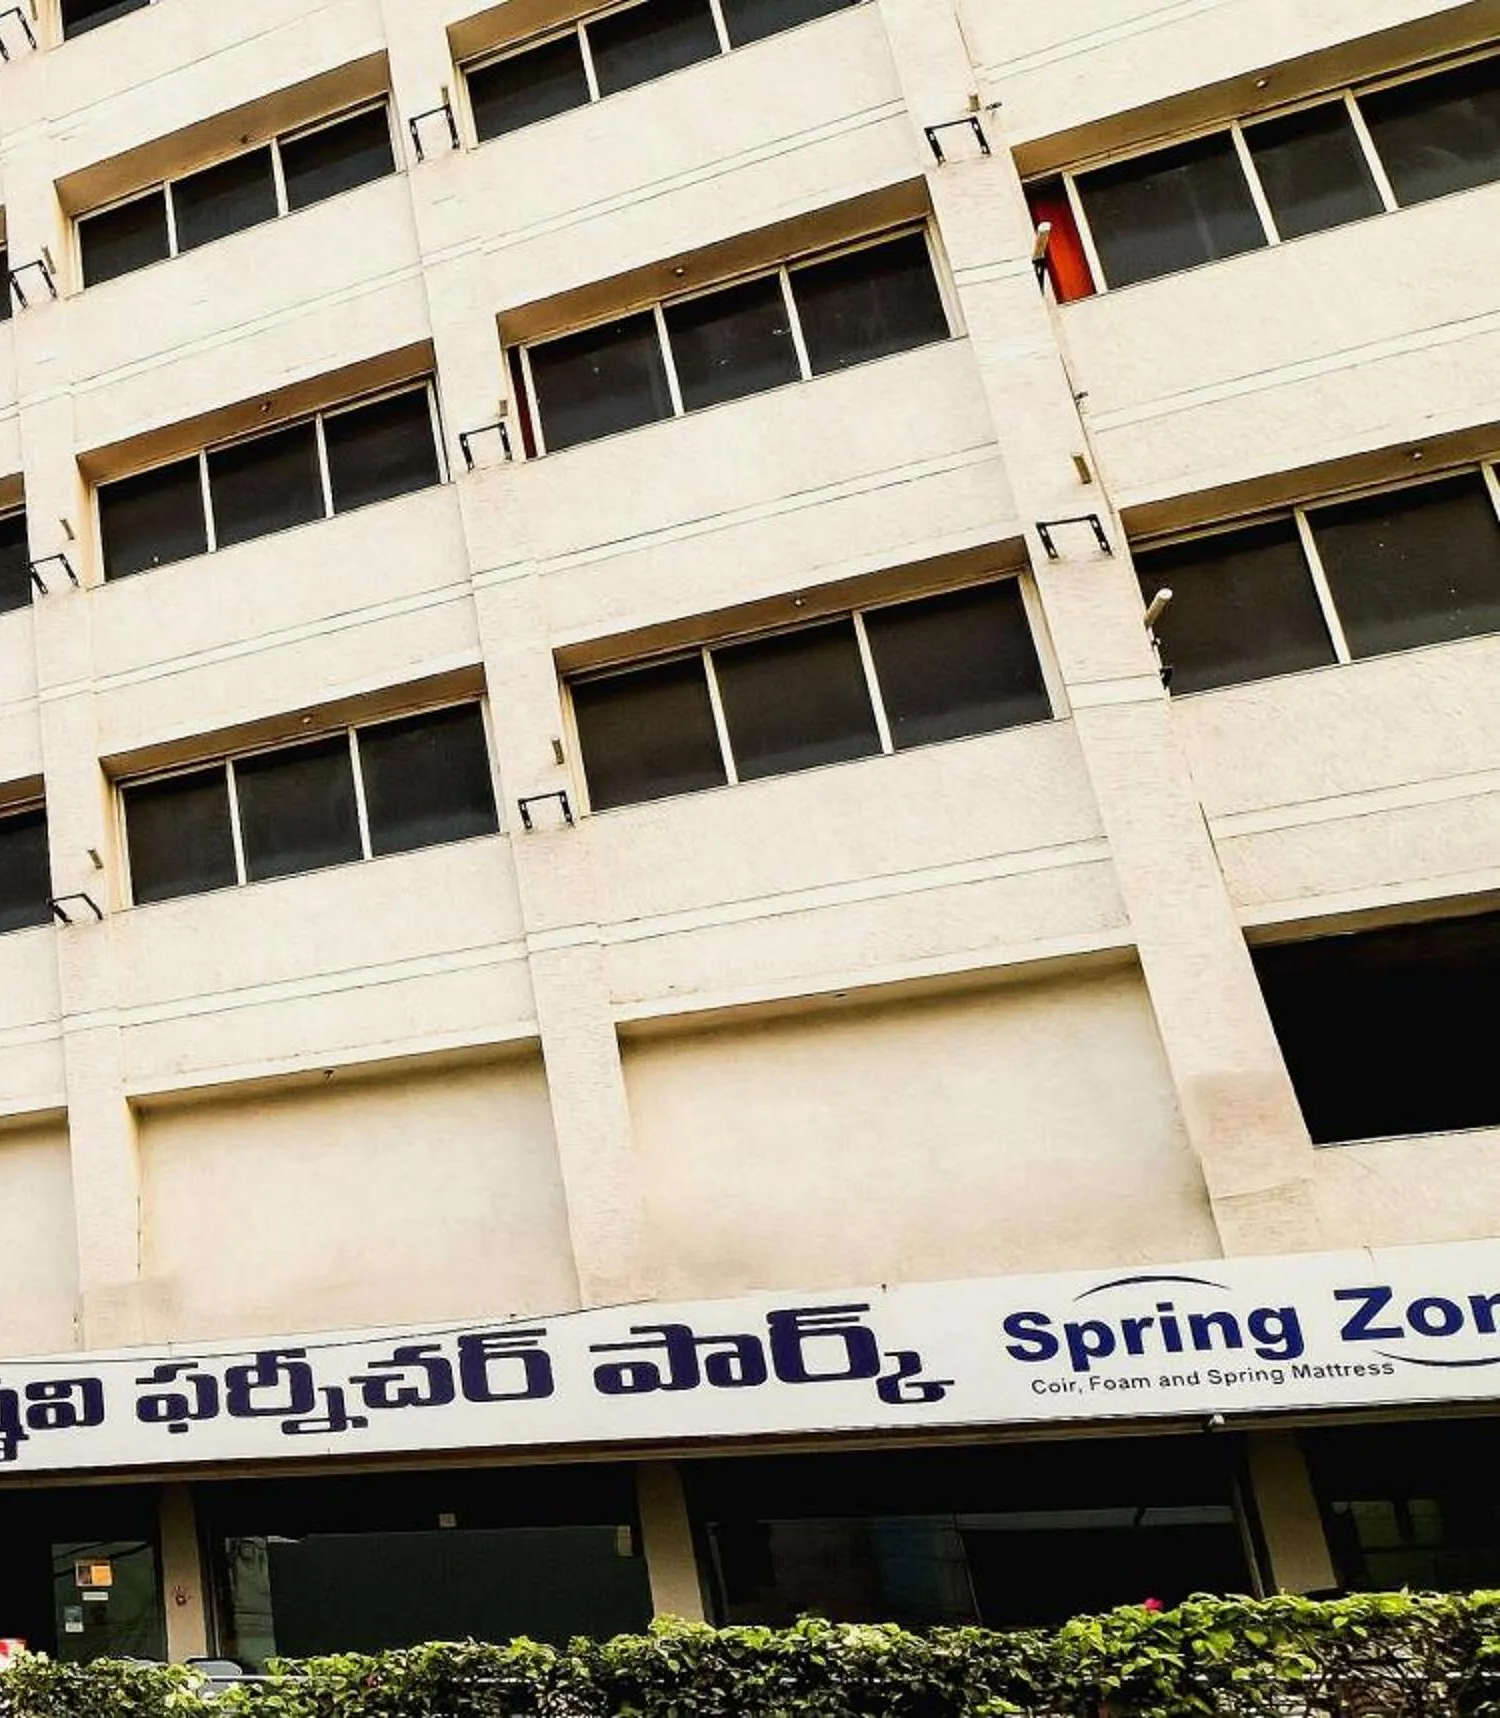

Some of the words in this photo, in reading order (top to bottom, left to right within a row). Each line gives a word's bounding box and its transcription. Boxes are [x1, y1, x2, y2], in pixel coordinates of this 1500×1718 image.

[589, 1302, 956, 1405] పార్క్
[1002, 1301, 1306, 1373] Spring
[1031, 1378, 1083, 1396] Coir,
[1089, 1375, 1152, 1393] Foam
[1158, 1369, 1201, 1388] and
[1207, 1364, 1285, 1387] Spring
[1291, 1360, 1396, 1380] Mattress
